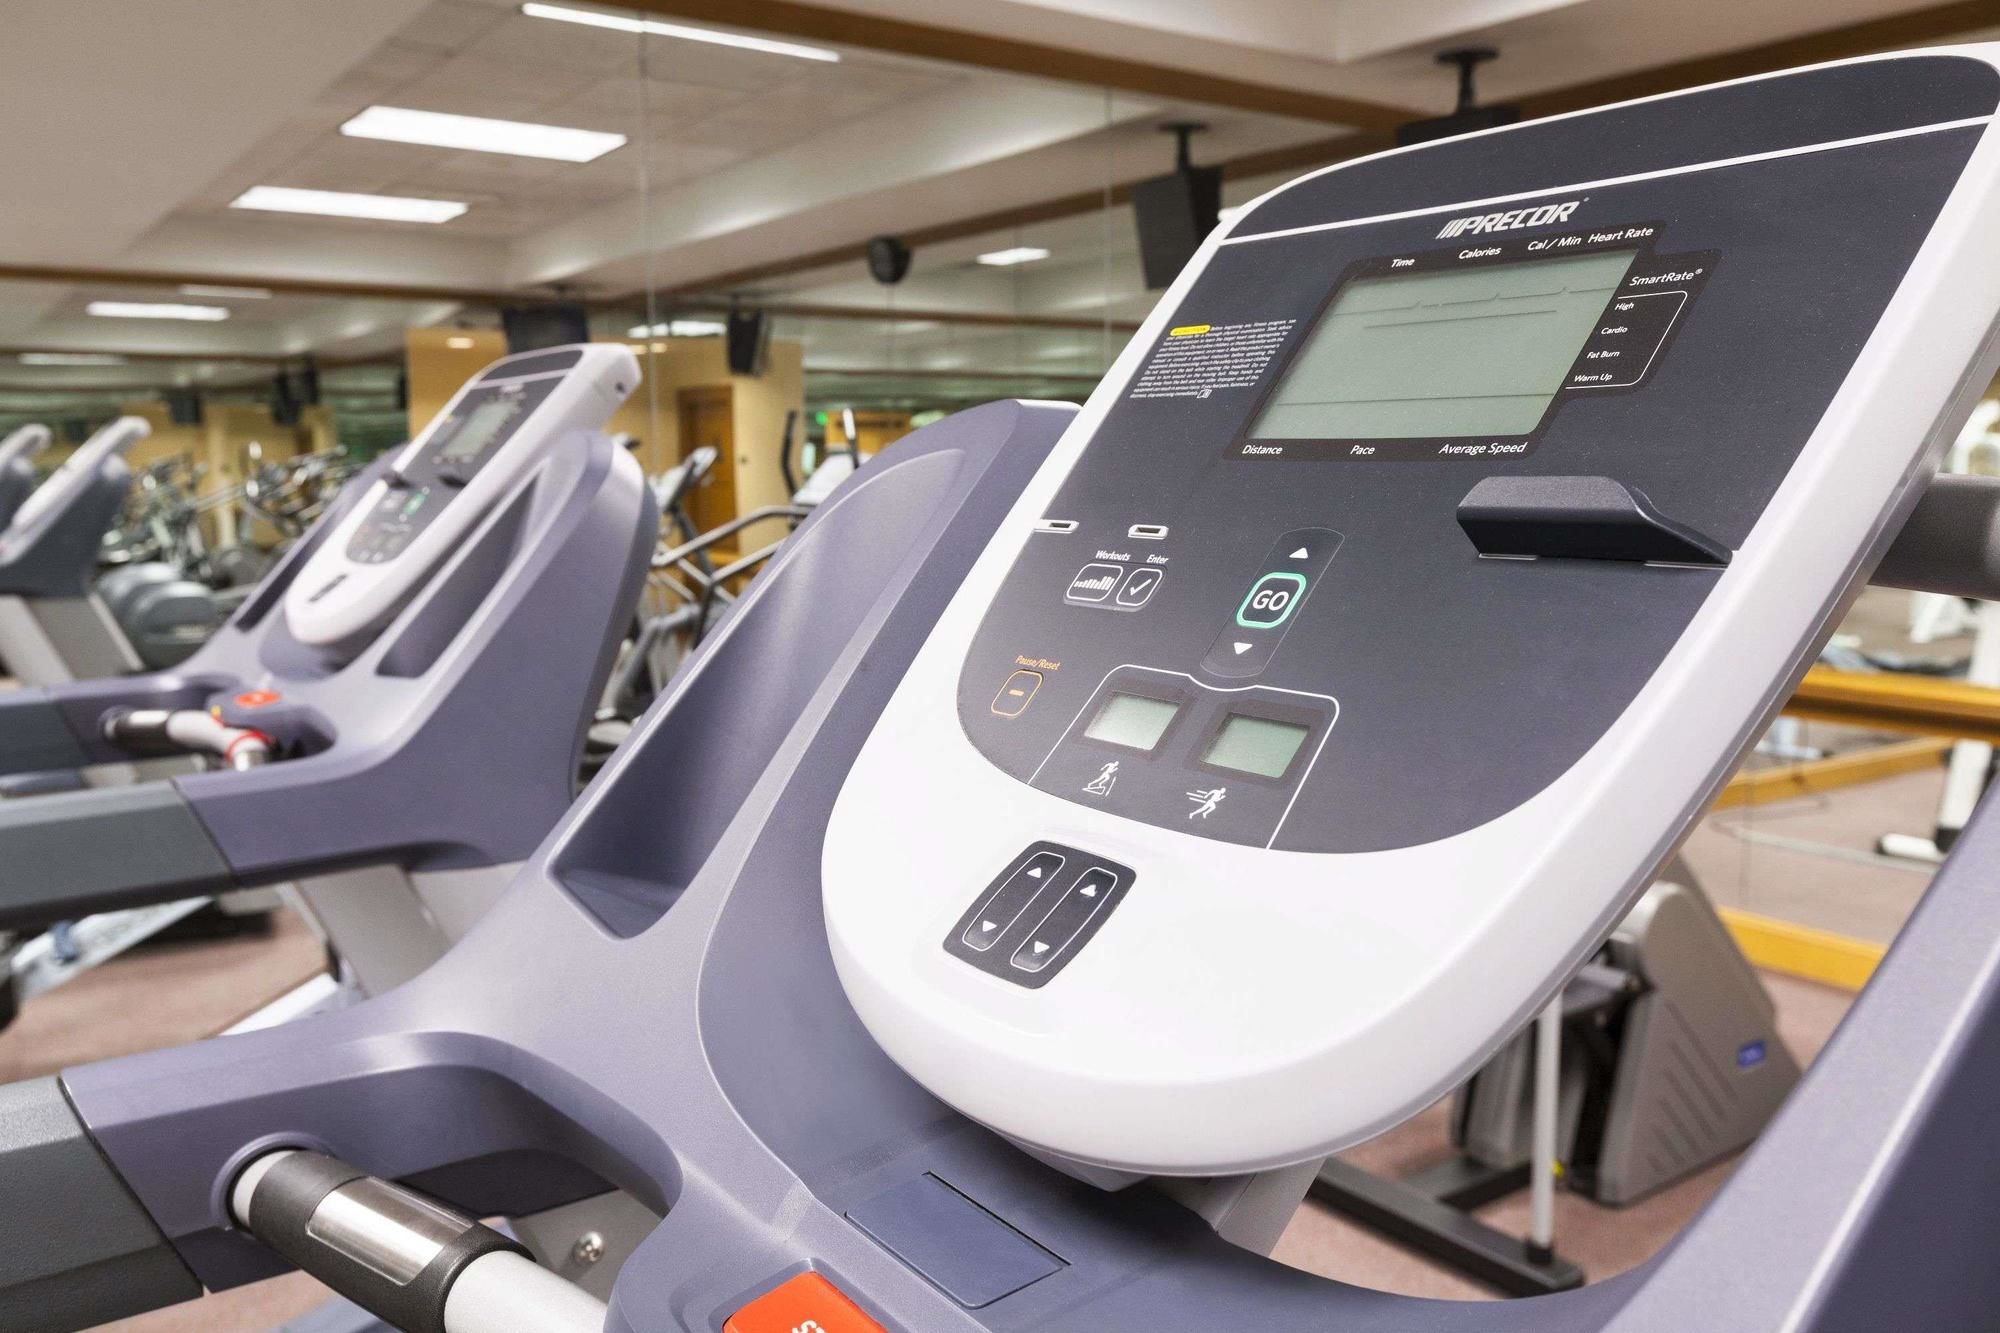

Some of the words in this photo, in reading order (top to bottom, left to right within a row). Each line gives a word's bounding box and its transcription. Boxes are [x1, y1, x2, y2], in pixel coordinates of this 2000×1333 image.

[1436, 201, 1580, 239] PRECOR
[1587, 231, 1623, 243] Heart
[1624, 227, 1654, 239] Rate
[1458, 247, 1502, 259] Calories
[1391, 258, 1415, 268] Time
[1614, 302, 1635, 311] High
[1600, 326, 1628, 335] Cardio
[1586, 351, 1601, 359] Fat
[1600, 350, 1620, 358] Burn
[1574, 374, 1599, 382] Warm
[1599, 373, 1613, 381] Up
[1242, 445, 1283, 455] Distance
[1350, 445, 1375, 455] Pace
[1438, 444, 1487, 455] Average
[1487, 442, 1528, 454] Speed
[1095, 550, 1131, 561] Workouts
[1146, 554, 1169, 564] Enter
[1252, 590, 1290, 611] GO
